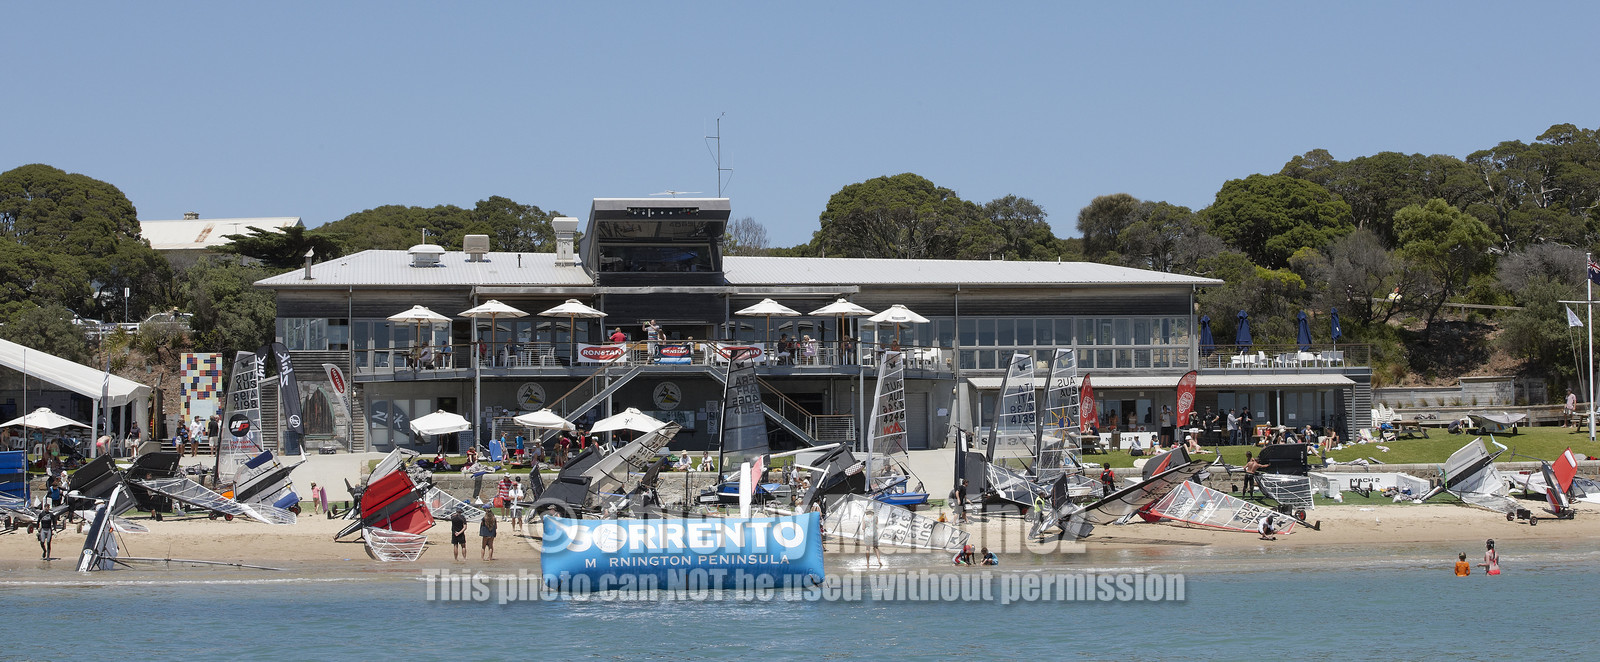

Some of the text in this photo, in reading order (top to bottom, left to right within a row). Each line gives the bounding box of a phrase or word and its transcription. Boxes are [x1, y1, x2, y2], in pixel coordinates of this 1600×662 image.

[1011, 413, 1035, 424] 4139
[567, 523, 804, 553] SORRENTO
[698, 555, 790, 565] PENINSULA
